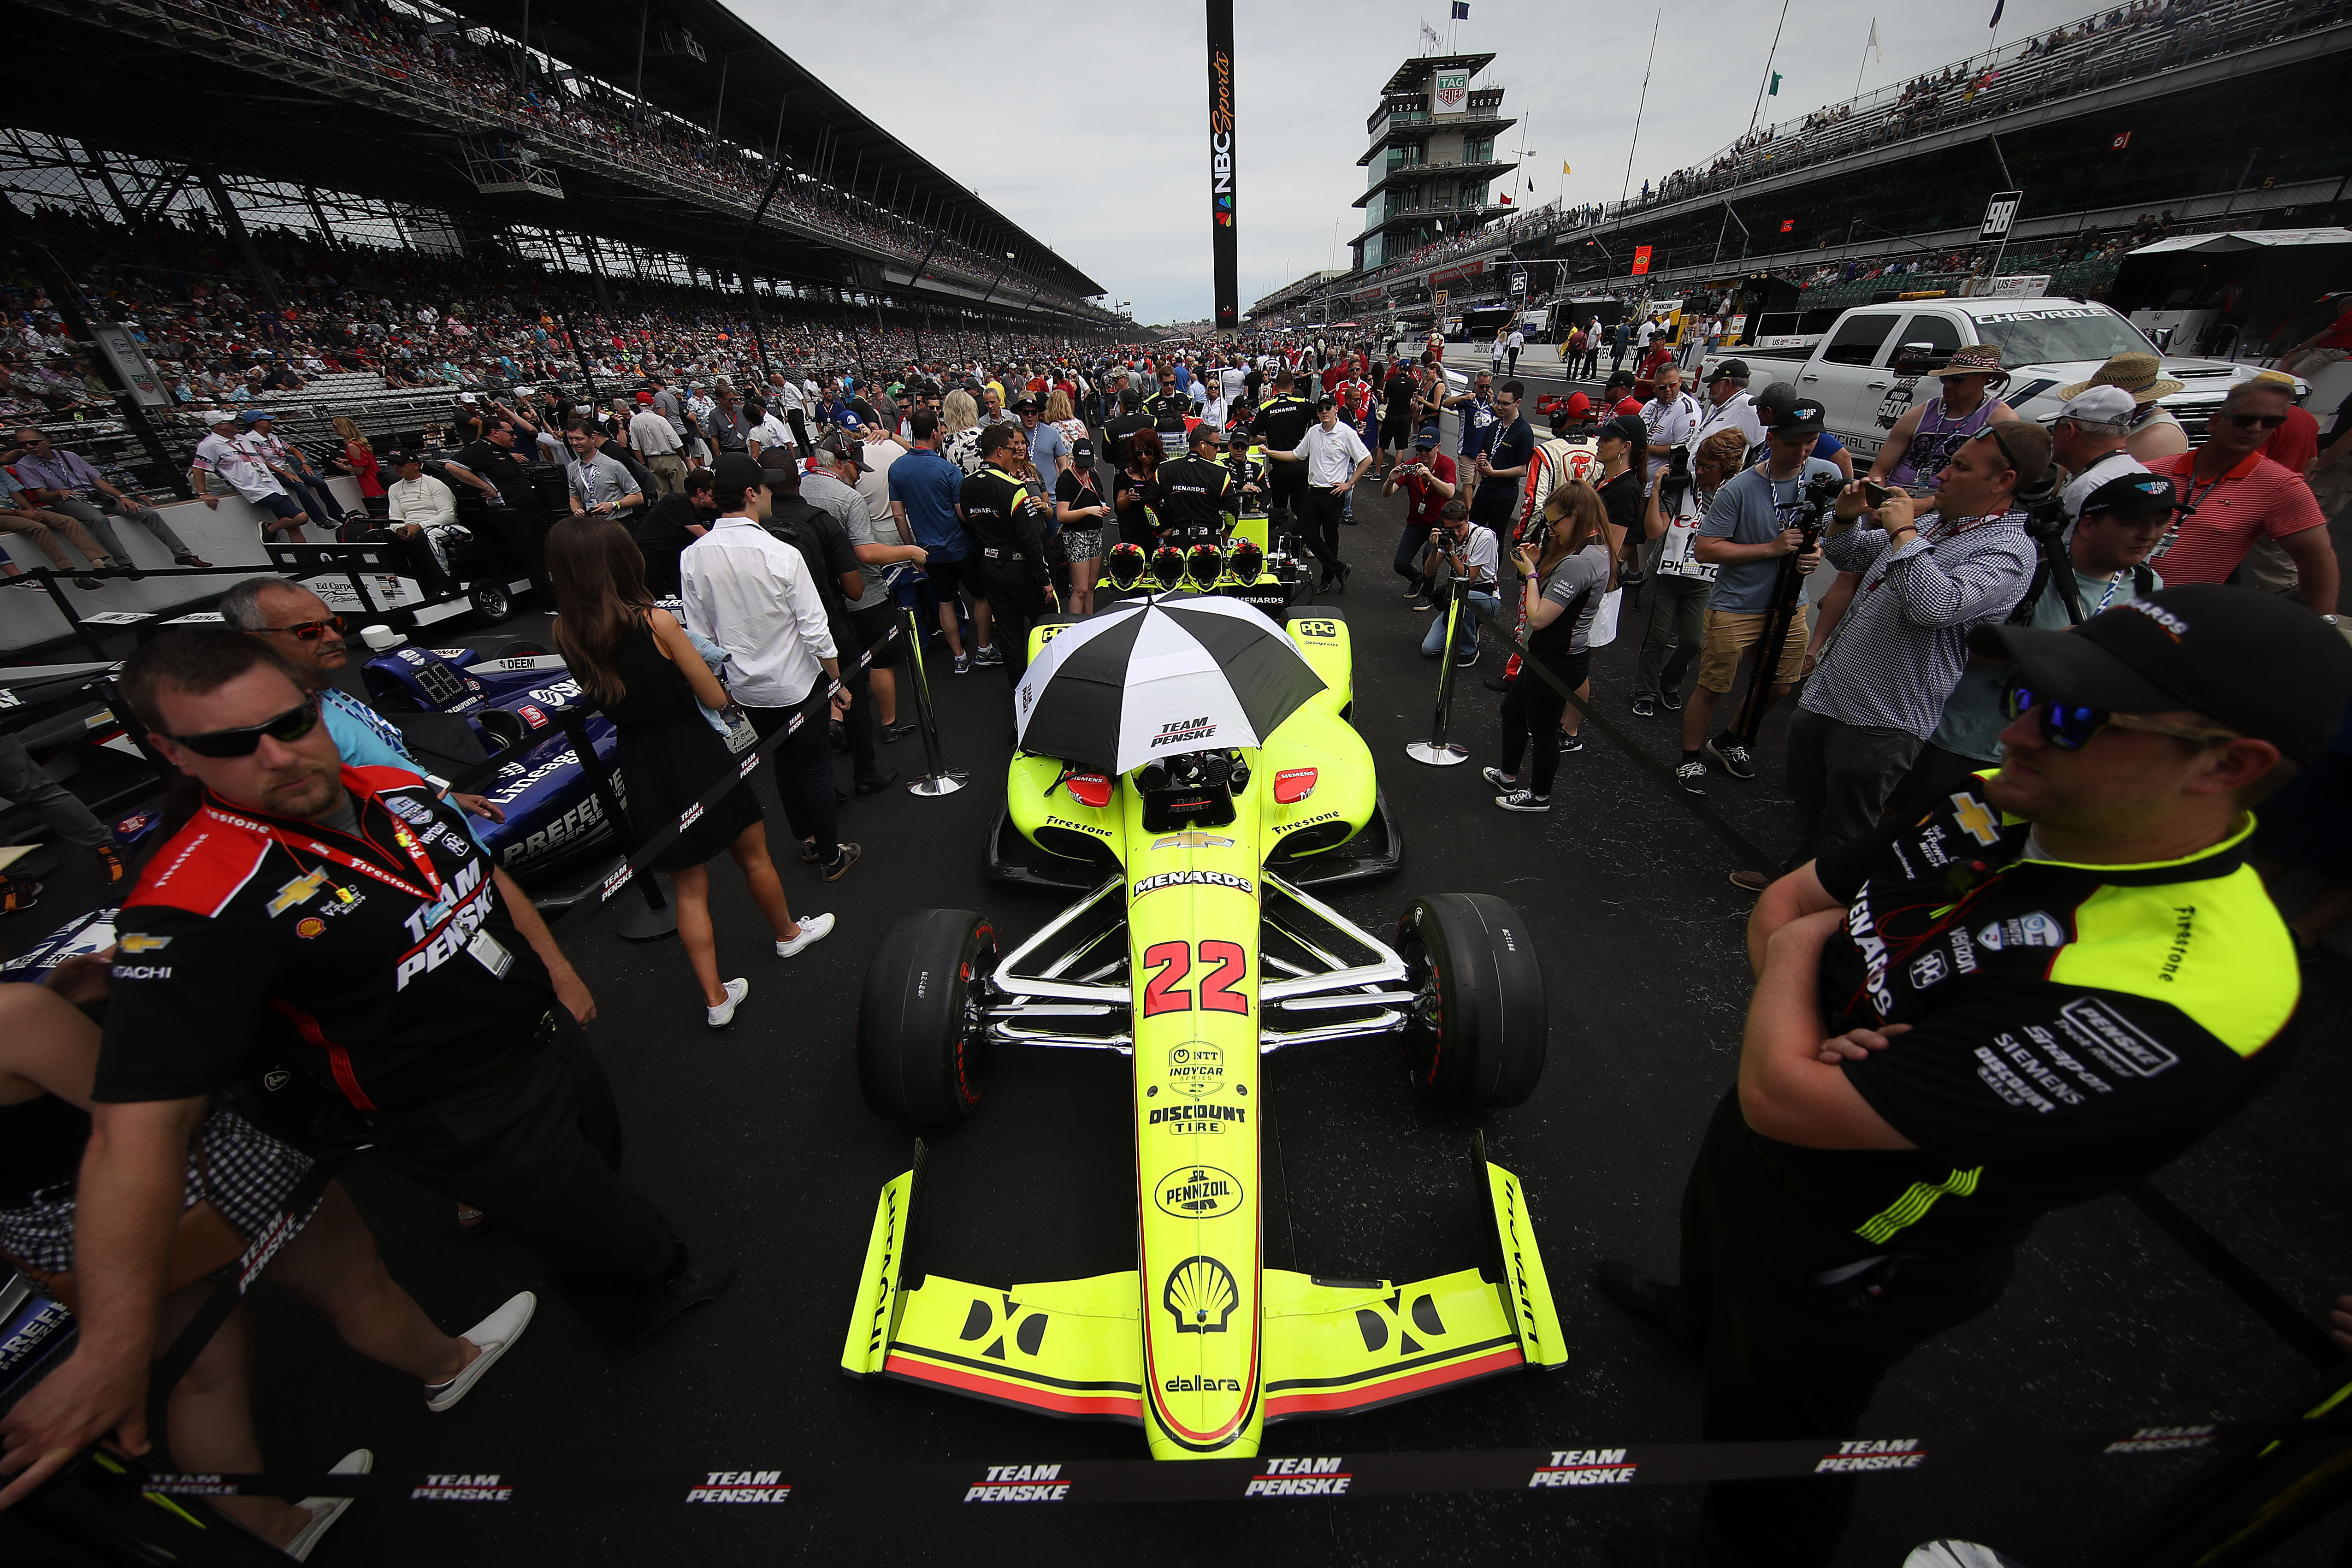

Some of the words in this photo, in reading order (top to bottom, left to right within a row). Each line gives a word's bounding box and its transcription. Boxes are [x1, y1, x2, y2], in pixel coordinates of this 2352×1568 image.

[1212, 50, 1234, 134] Sports
[1441, 77, 1464, 89] TAG
[1439, 89, 1464, 103] HEUER
[1213, 132, 1231, 193] NBC
[2262, 177, 2275, 189] 5
[1983, 201, 2015, 234] 98
[1513, 276, 1525, 290] 25
[1997, 279, 2009, 289] US
[1437, 293, 1446, 304] 27
[1976, 308, 2113, 325] CHEVROLET
[1891, 391, 1909, 401] INDY
[1270, 406, 1296, 414] MENARDS
[1879, 400, 1912, 418] 500
[1661, 560, 1719, 578] PHTO
[316, 581, 330, 592] Ed
[1301, 621, 1335, 636] PPG
[508, 658, 535, 669] DEEM
[861, 649, 870, 661] TEAM
[827, 682, 841, 698] PENSKE
[828, 678, 839, 691] TEAM
[452, 696, 478, 712] CARPENTER
[532, 718, 546, 726] Speedway
[788, 715, 804, 735] PENSKE
[789, 711, 801, 726] TEAM
[1162, 716, 1209, 733] TEAM
[734, 735, 756, 752] Firestone
[1151, 727, 1217, 747] PENSKE
[740, 757, 760, 779] PENSKE
[741, 752, 756, 769] TEAM
[1070, 775, 1103, 783] SIEMENS
[1281, 770, 1315, 780] SIEMENS
[397, 799, 411, 809] NTT
[1176, 796, 1205, 804] TEAM
[680, 801, 699, 822] TEAM
[679, 809, 704, 834] PENSKE
[1047, 816, 1112, 837] Firestone
[1272, 811, 1339, 835] Firestone
[418, 821, 448, 845] verizon
[1931, 824, 1947, 840] Shell
[446, 836, 465, 855] PPG
[1921, 828, 1950, 864] V-Power
[155, 833, 209, 888] Firestone
[350, 857, 423, 896] Firestone
[603, 863, 627, 889] TEAM
[1133, 871, 1253, 897] MENARDS
[602, 870, 633, 902] PENSKE
[397, 878, 492, 992] PENSKE
[2157, 905, 2195, 983] Firestone
[1949, 926, 1977, 974] verizon
[1912, 953, 1942, 986] PPG
[1143, 940, 1249, 1019] 22
[2075, 1006, 2161, 1065] PENSKE
[1193, 1051, 1217, 1060] NTT
[2022, 1025, 2114, 1095] Snap-on
[1169, 1067, 1223, 1077] INDYCAR
[1994, 1032, 2086, 1104] SIEMENS
[1974, 1045, 2058, 1113] DISCOUNT
[1149, 1104, 1245, 1124] DISCOUNT
[1175, 1122, 1219, 1132] TIRE
[1166, 1180, 1230, 1205] PENNZOIL
[240, 1210, 284, 1269] TEAM
[239, 1212, 297, 1295] PENSKE
[1506, 1178, 1539, 1344] HITACHI
[869, 1187, 897, 1354] HITACHI
[1165, 1375, 1241, 1392] dallara
[1838, 1438, 1918, 1454] TEAM
[1265, 1457, 1342, 1475] TEAM
[1548, 1448, 1626, 1467] TEAM
[1814, 1454, 1925, 1473] PENSKE
[148, 1474, 221, 1483] TEAM
[426, 1474, 500, 1486] TEAM
[705, 1471, 782, 1485] TEAM
[985, 1464, 1062, 1482] TEAM
[1529, 1468, 1636, 1488] PENSKE
[142, 1484, 239, 1495] PENSKE
[411, 1489, 512, 1501] PENSKE
[963, 1485, 1069, 1503] PENSKE
[1244, 1477, 1351, 1496] PENSKE
[686, 1489, 791, 1503] PENSKE
